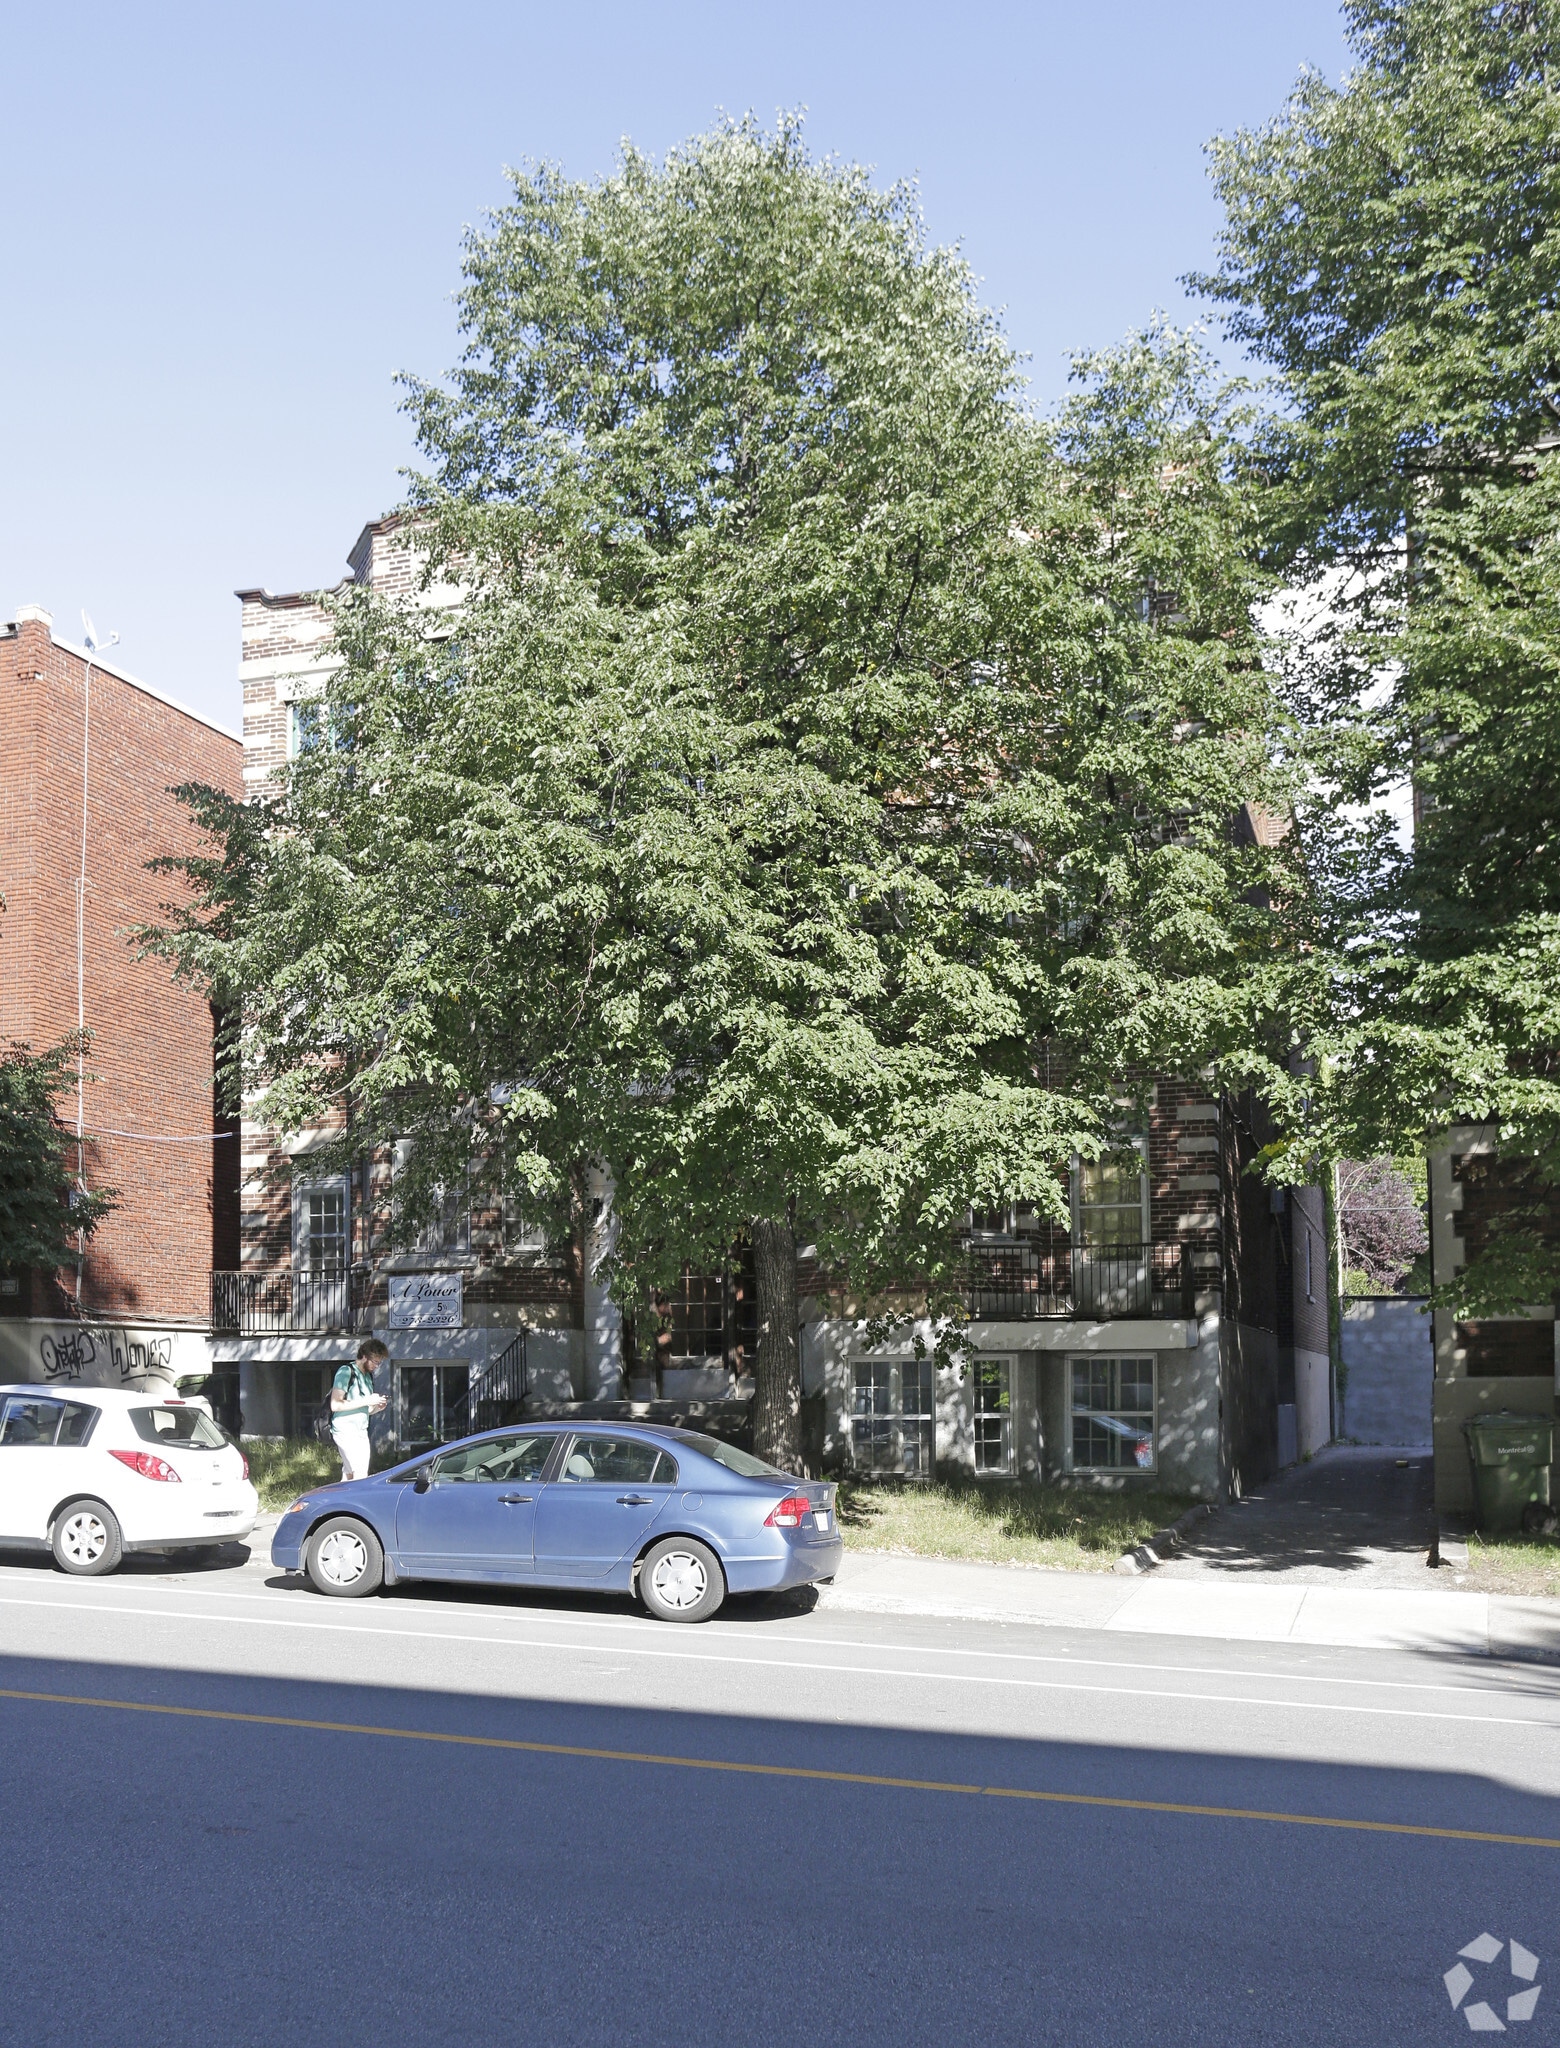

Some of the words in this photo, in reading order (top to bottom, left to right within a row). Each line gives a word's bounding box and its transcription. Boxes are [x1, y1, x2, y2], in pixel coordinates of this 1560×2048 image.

[392, 1280, 412, 1298] À
[411, 1283, 458, 1300] Louer
[1497, 1446, 1527, 1454] Montréal
